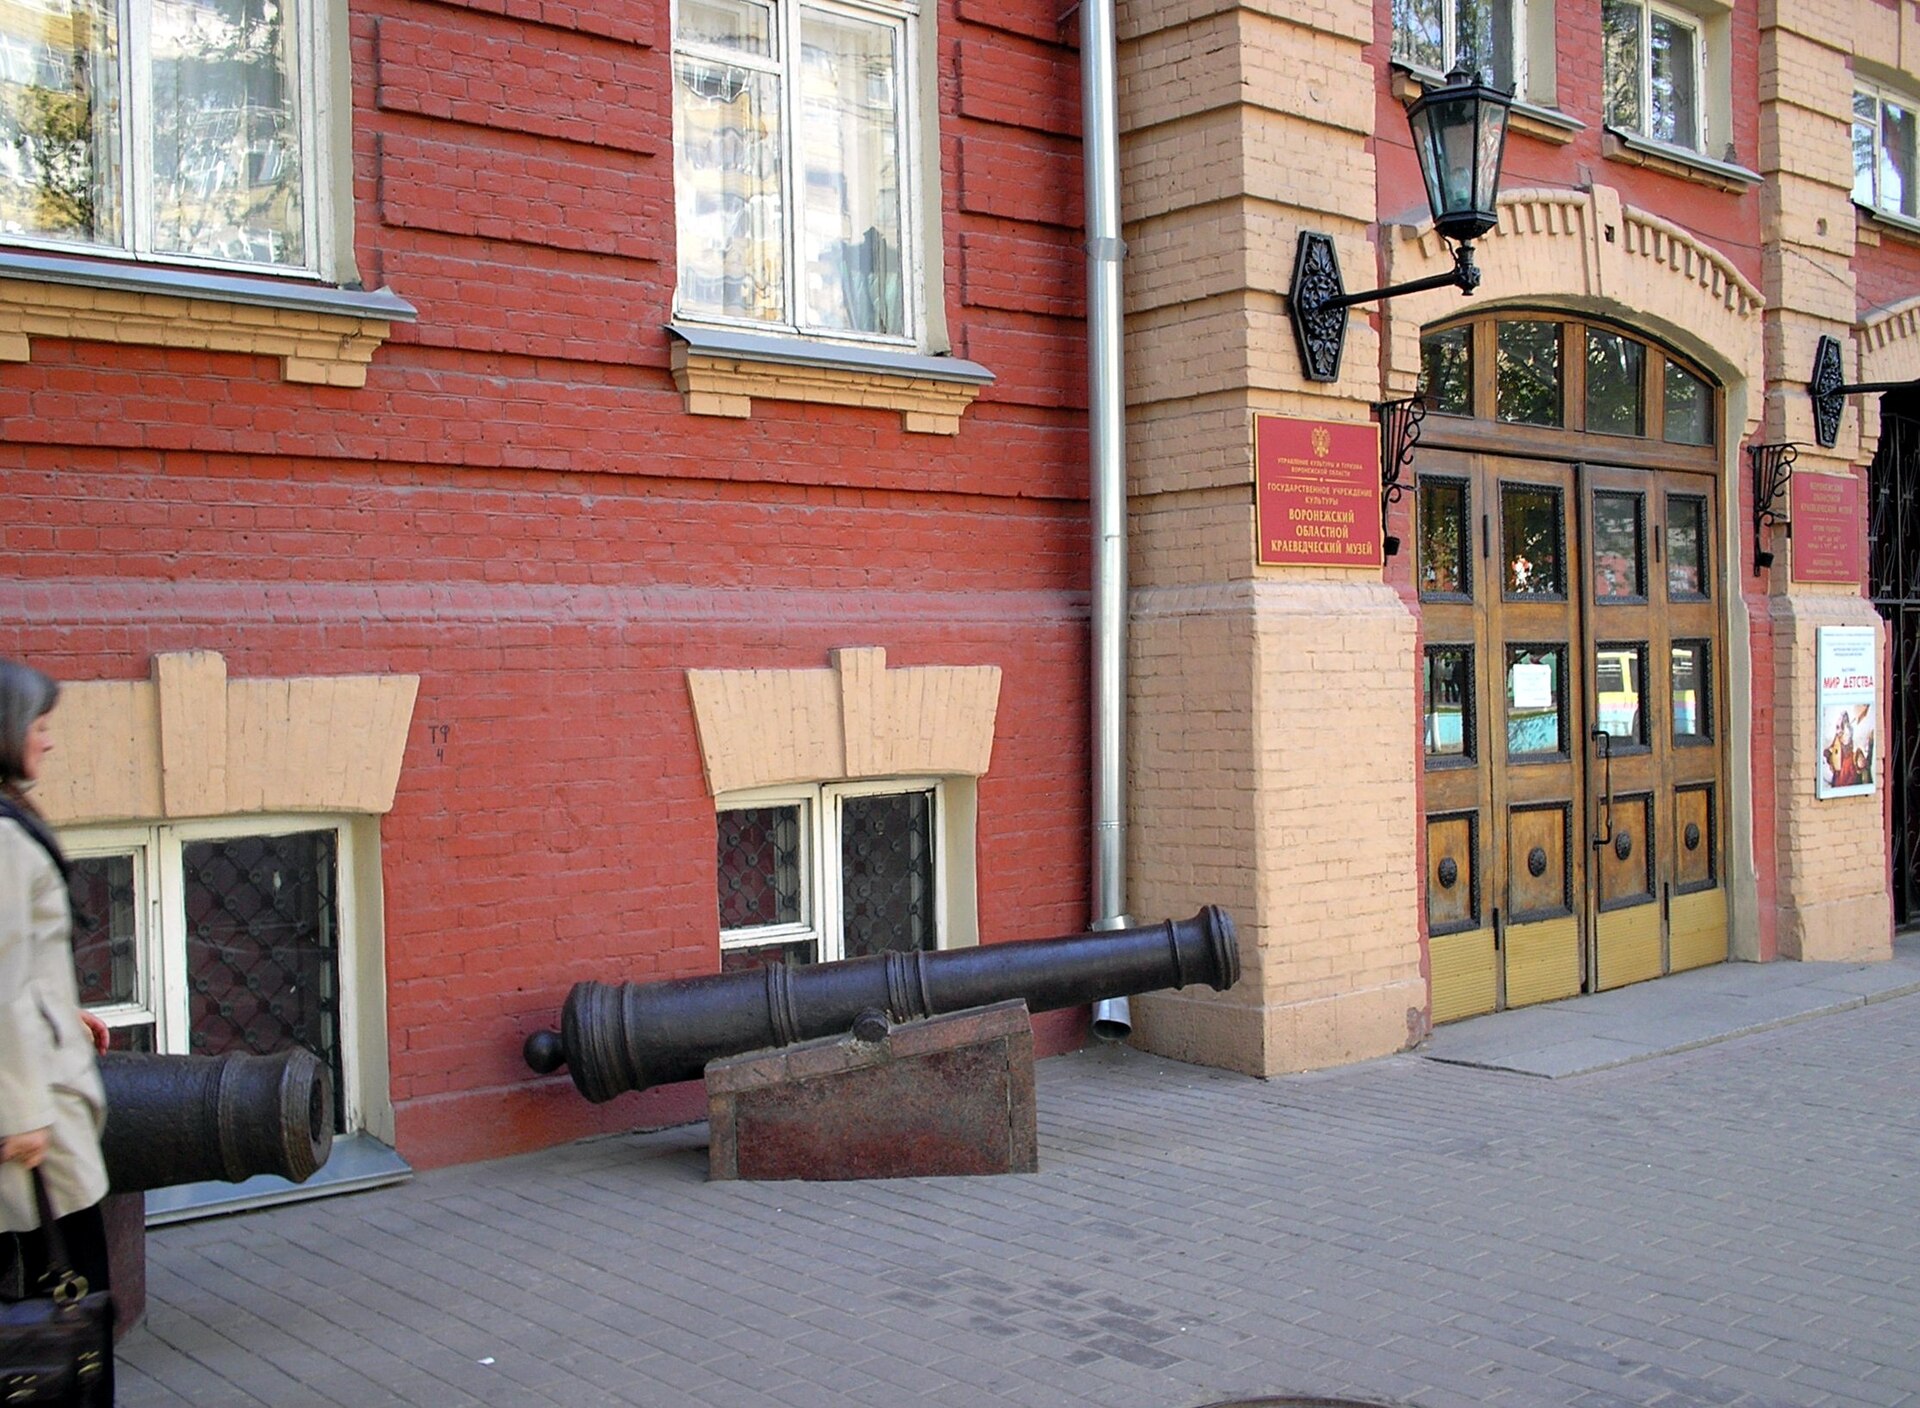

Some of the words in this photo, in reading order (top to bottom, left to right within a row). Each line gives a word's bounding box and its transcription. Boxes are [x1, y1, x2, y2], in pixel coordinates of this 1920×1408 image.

[1267, 482, 1330, 495] ГОСУДАРСТВЕННОЕ
[1332, 488, 1373, 498] УЧРЕЖДЕНИЕ
[1305, 497, 1338, 506] КУЛЬТУРЫ
[1288, 508, 1354, 524] ВОРОНЕЖСКИЙ
[1296, 524, 1349, 538] ОБЛАСТНОЙ
[1271, 540, 1342, 554] КРАЕВЕДЧЕСКИЙ
[1346, 541, 1373, 555] МУЗЕЙ
[1823, 676, 1840, 688] МИР
[1843, 676, 1874, 688] ДЕТСТВА
